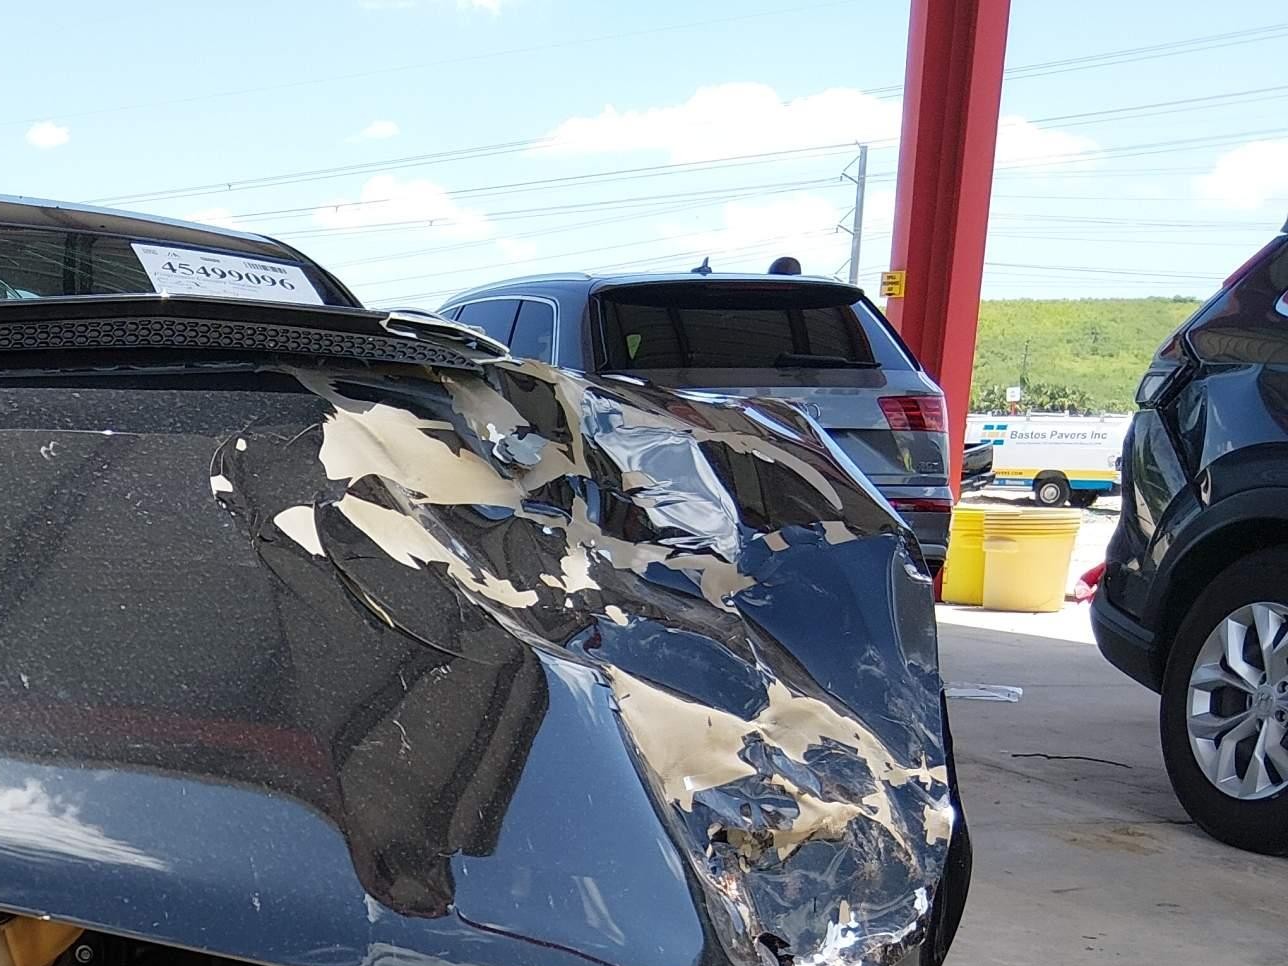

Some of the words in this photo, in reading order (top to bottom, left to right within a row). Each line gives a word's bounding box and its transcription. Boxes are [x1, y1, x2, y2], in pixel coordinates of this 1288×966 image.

[161, 261, 296, 291] 45499096
[1010, 430, 1047, 440] Bastos
[1090, 430, 1108, 440] Inc
